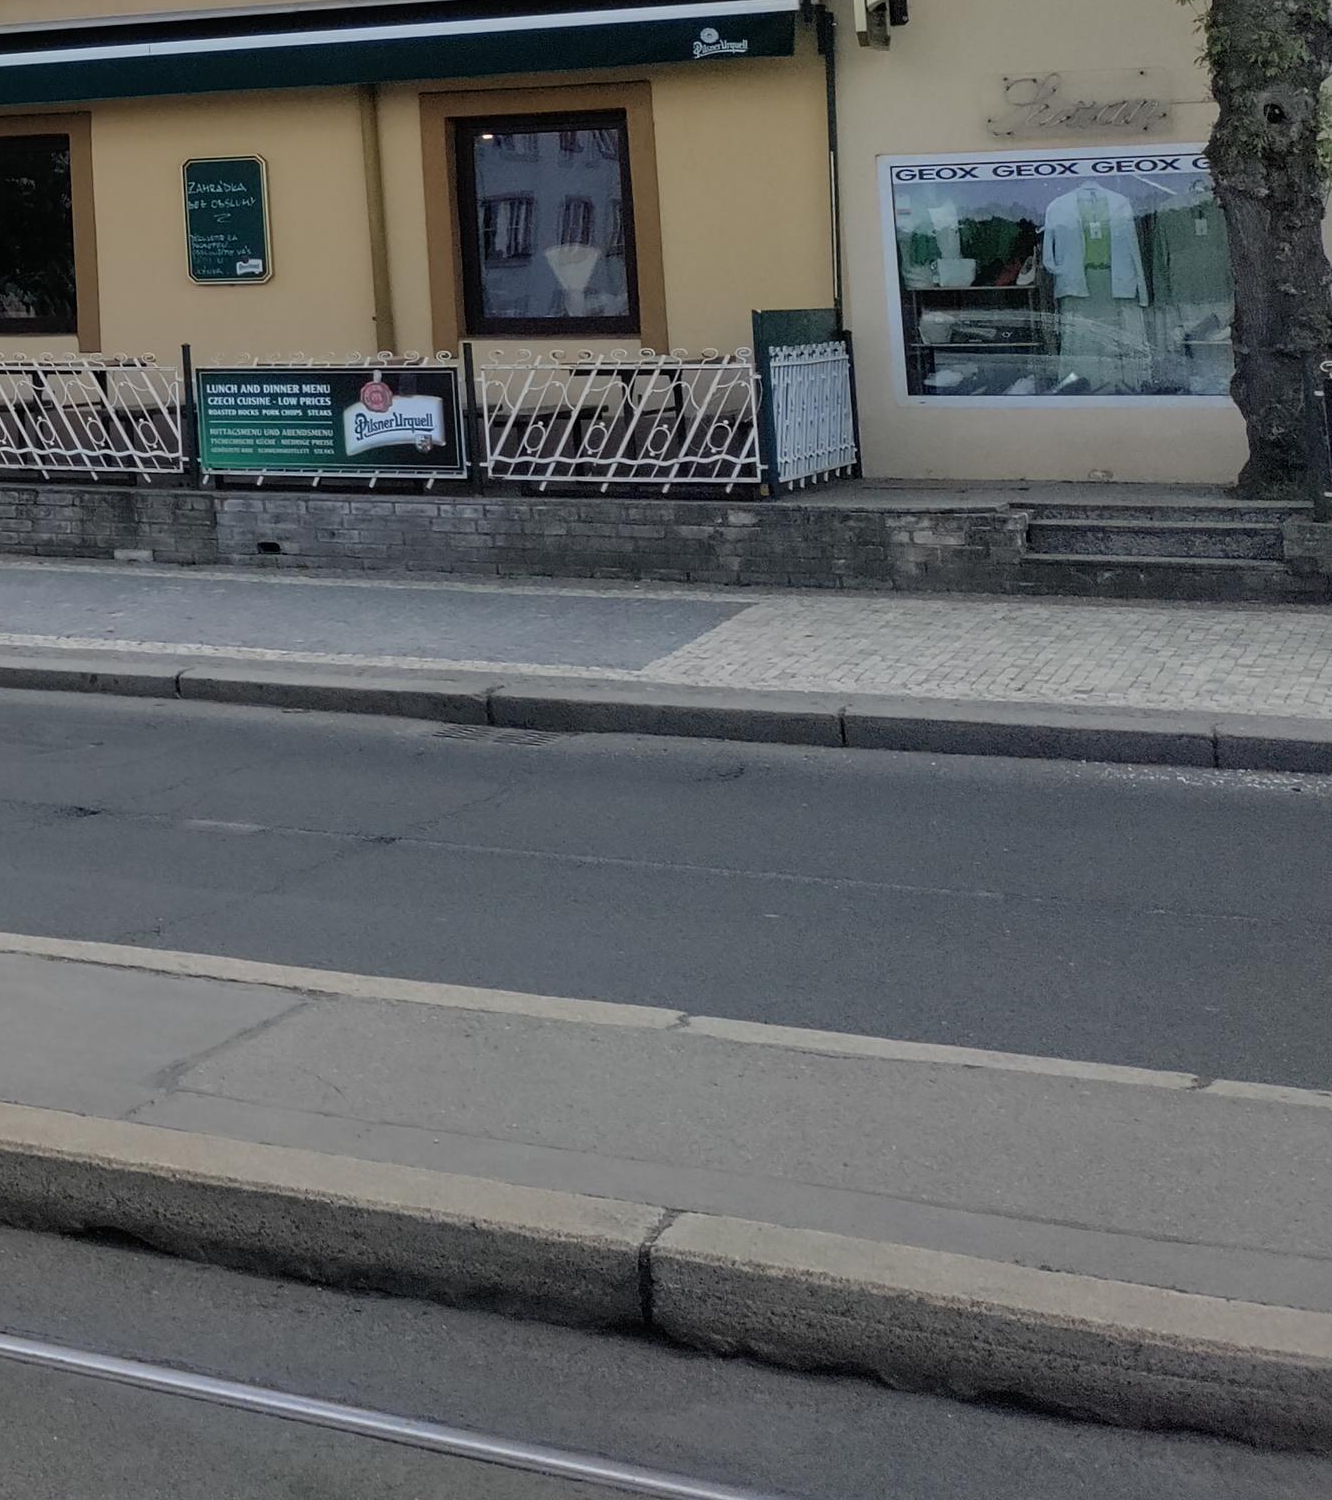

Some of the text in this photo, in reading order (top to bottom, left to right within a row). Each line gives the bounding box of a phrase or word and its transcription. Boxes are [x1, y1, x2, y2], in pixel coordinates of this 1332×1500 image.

[895, 166, 980, 182] GEOX
[991, 162, 1080, 178] GEOX
[1091, 158, 1181, 174] GEOX
[188, 180, 247, 194] ZAHRÁDKA
[206, 384, 331, 394] LUNCH AND DINNER MENU
[207, 396, 235, 406] CZECH
[237, 396, 271, 406] CUISINE
[278, 396, 297, 406] LOW
[299, 396, 332, 406] PRICES
[307, 409, 333, 417] STEAKS
[355, 411, 434, 441] Pilsner Urquell
[264, 428, 280, 436] UND
